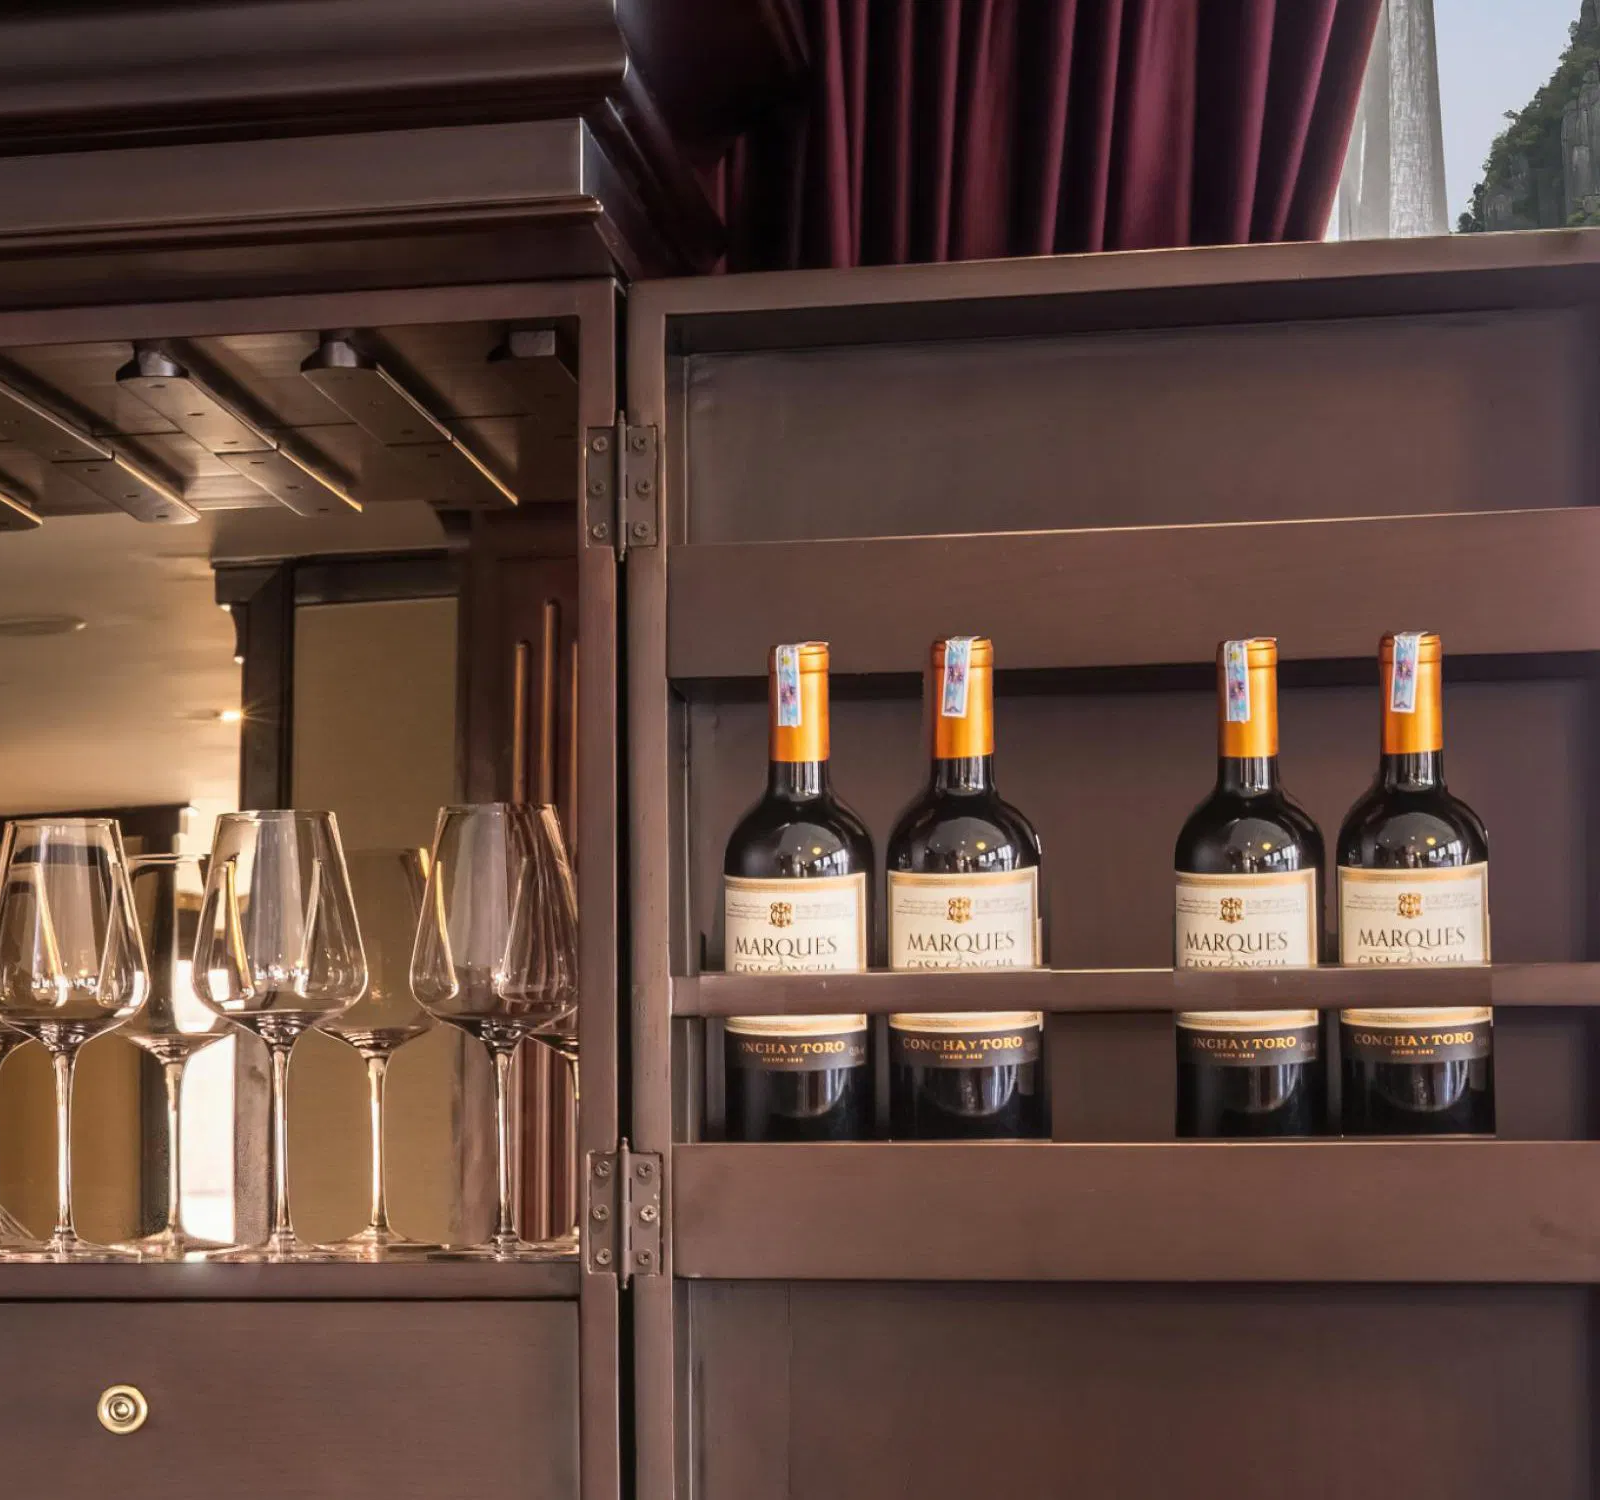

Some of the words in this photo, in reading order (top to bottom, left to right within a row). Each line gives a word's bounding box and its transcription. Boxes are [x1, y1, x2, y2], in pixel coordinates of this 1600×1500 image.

[906, 931, 1015, 954] MARQUES
[1185, 932, 1288, 954] MARQUES
[1358, 927, 1465, 949] MARQUES
[734, 936, 837, 959] MARQUES
[789, 1044, 798, 1054] Y
[800, 1040, 845, 1054] TORO
[903, 1038, 967, 1051] CONCHA
[968, 1041, 977, 1050] Y
[980, 1036, 1022, 1049] TORO
[1241, 1040, 1249, 1049] Y
[1251, 1036, 1297, 1049] TORO
[1354, 1033, 1418, 1046] CONCHA
[1420, 1036, 1428, 1045] Y
[1431, 1032, 1474, 1045] TORO
